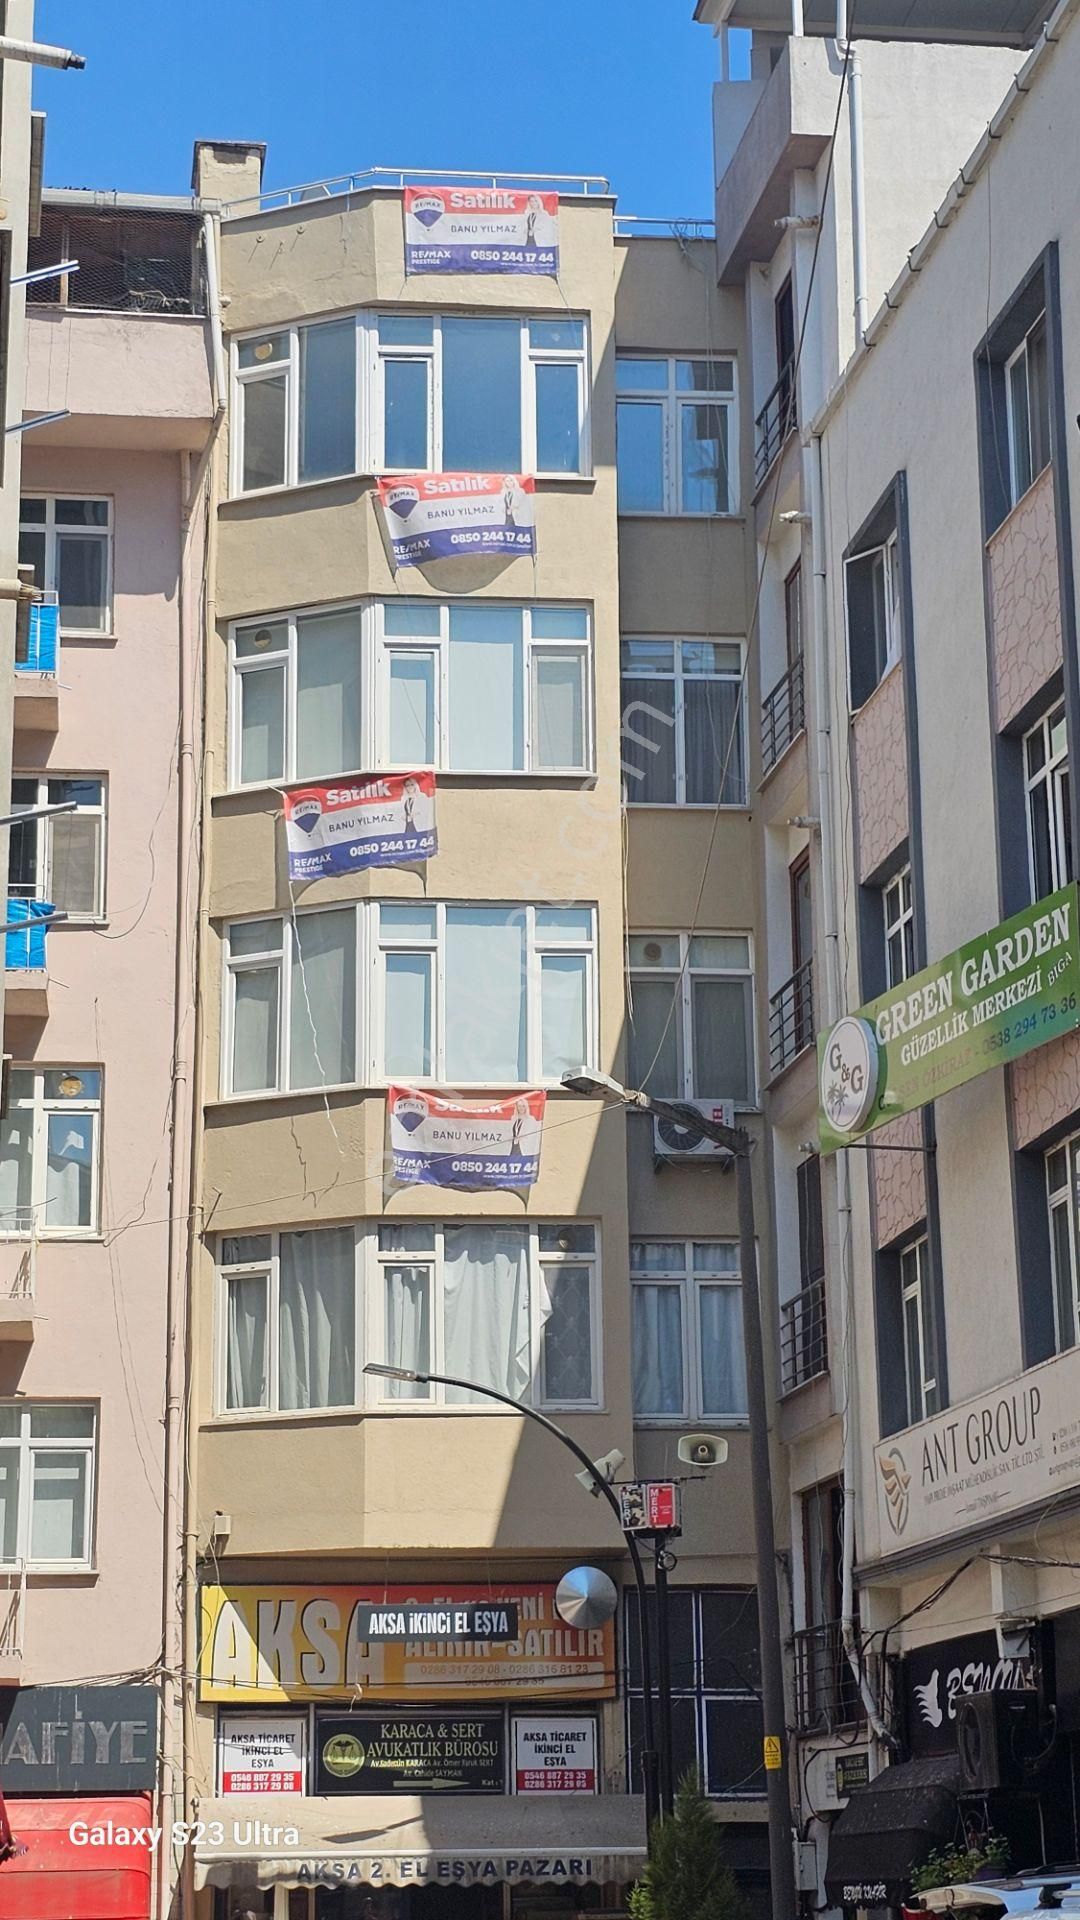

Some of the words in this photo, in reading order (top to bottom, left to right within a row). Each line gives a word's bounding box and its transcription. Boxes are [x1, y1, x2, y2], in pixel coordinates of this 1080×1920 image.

[450, 192, 516, 209] Satılık
[451, 224, 478, 233] BANU
[481, 225, 518, 233] YILMAZ
[411, 250, 451, 259] RE/MAX
[470, 251, 500, 261] 0850
[501, 251, 523, 262] 244
[525, 252, 537, 262] 17
[538, 252, 554, 262] 44
[424, 476, 491, 494] Satılık
[427, 507, 455, 520] BANU
[457, 505, 496, 518] YILMAZ
[450, 533, 481, 544] 0850
[482, 531, 504, 543] 244
[504, 532, 515, 543] 17
[516, 533, 532, 543] 44
[393, 539, 431, 555] RE/MAX
[326, 779, 392, 806] Satılık
[328, 820, 356, 833] BANU
[357, 813, 395, 827] YILMAZ
[350, 842, 378, 857] 0850
[381, 839, 404, 853] 244
[405, 839, 418, 849] 17
[419, 835, 435, 848] 44
[294, 852, 332, 867] RE/MAX
[876, 971, 954, 1046] GREEN
[960, 902, 1071, 997] GARDEN
[901, 1011, 969, 1066] GÜZELLİK
[972, 965, 1042, 1026] MERKEZİ
[1014, 1013, 1038, 1039] 294
[1041, 1003, 1056, 1024] 73
[1061, 991, 1077, 1014] 36
[432, 1131, 461, 1140] BANU
[465, 1132, 503, 1142] YILMAZ
[452, 1161, 481, 1173] 0850
[485, 1162, 508, 1174] 244
[509, 1163, 522, 1174] 17
[524, 1161, 538, 1173] 44
[922, 1422, 959, 1487] ANT
[965, 1386, 1041, 1465] GROUP
[622, 1491, 632, 1526] MERT
[650, 1489, 658, 1523] MERT
[368, 1612, 405, 1635] AKSA
[454, 1611, 471, 1634] EL
[474, 1611, 509, 1636] EŞYA
[211, 1598, 384, 1690] AKSA
[231, 1733, 255, 1744] AKSA
[258, 1731, 296, 1744] TİCARET
[381, 1723, 434, 1739] KARACA
[437, 1723, 448, 1739] &
[451, 1723, 485, 1739] SERT
[523, 1732, 548, 1742] AKSA
[550, 1730, 587, 1742] TİCARET
[366, 1741, 442, 1758] AVUKATLIK
[445, 1739, 498, 1757] BÜROSU
[534, 1743, 563, 1754] İKİNCİ
[565, 1744, 577, 1754] EL
[251, 1758, 275, 1769] EŞYA
[544, 1756, 567, 1767] EŞYA
[283, 1773, 294, 1782] 35
[253, 1782, 270, 1791] 317
[297, 1861, 363, 1881] AKSA
[371, 1862, 391, 1880] 2.
[400, 1861, 428, 1879] EL
[437, 1860, 498, 1881] EŞYA
[505, 1859, 592, 1877] PAZARI
